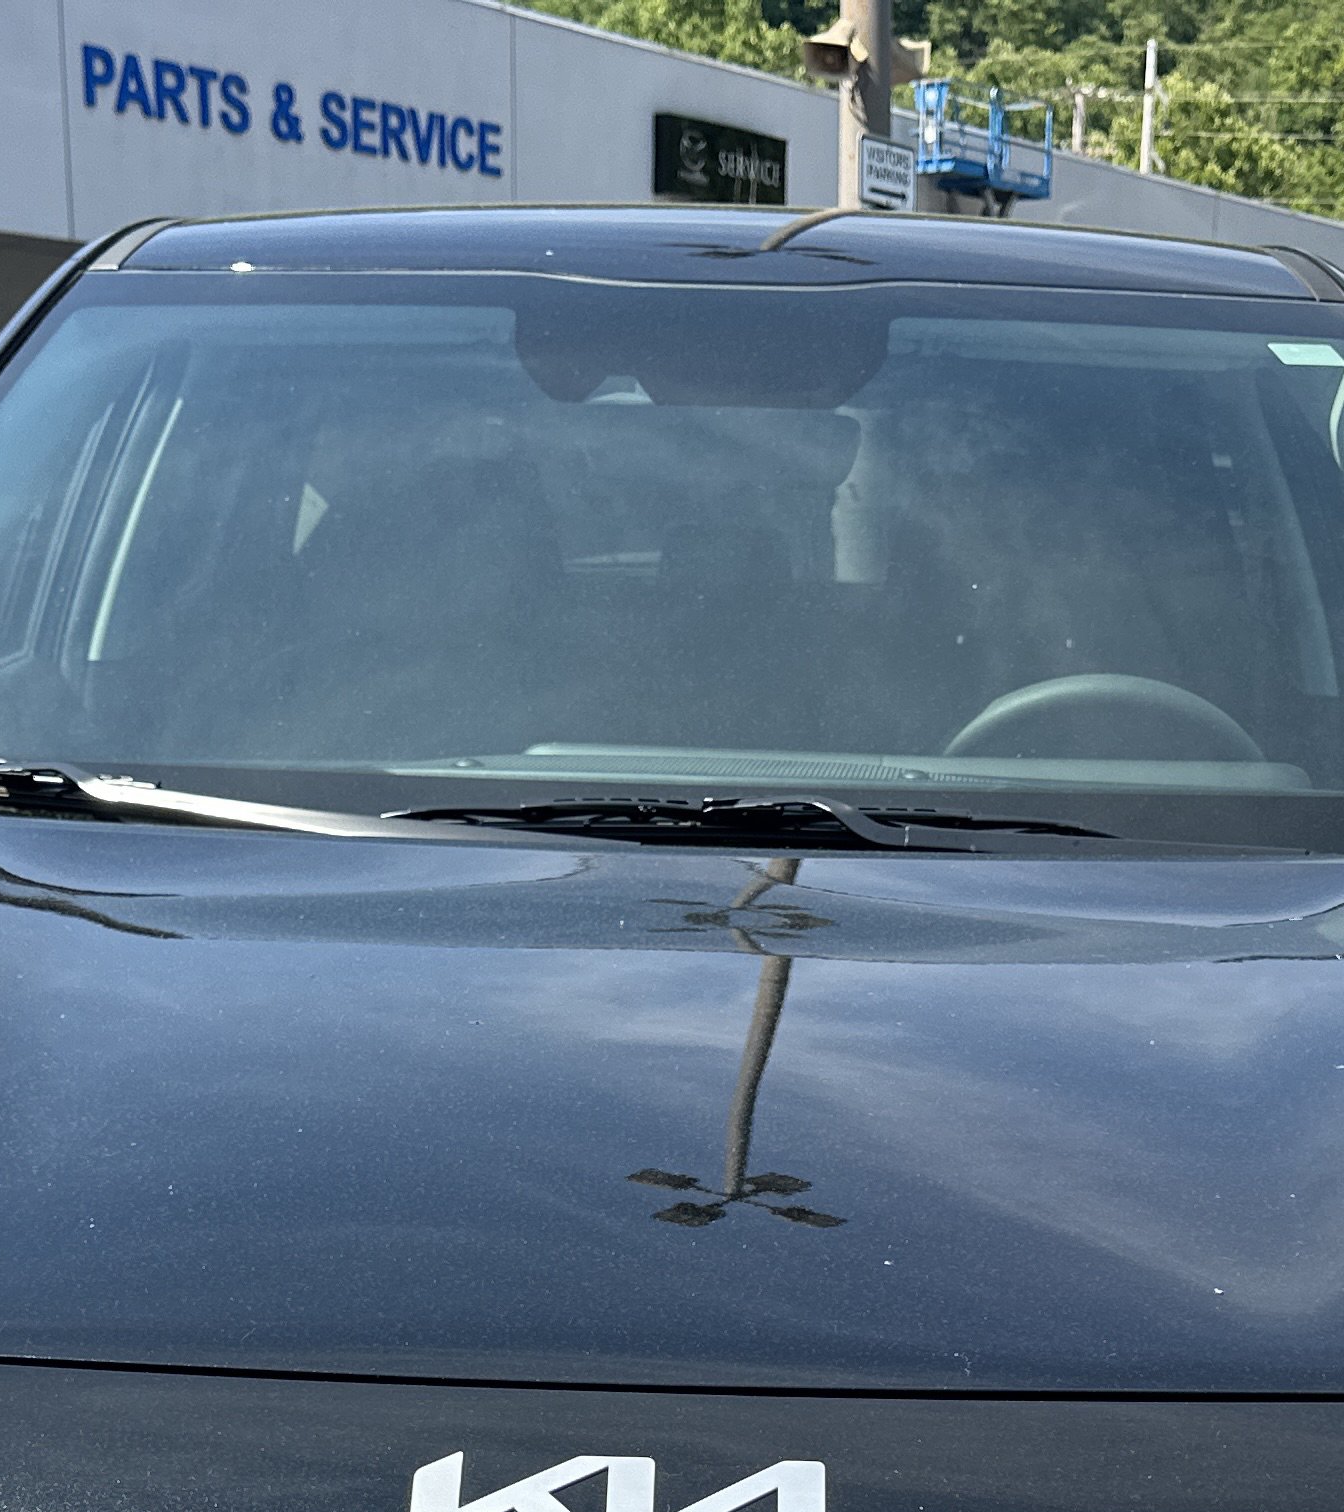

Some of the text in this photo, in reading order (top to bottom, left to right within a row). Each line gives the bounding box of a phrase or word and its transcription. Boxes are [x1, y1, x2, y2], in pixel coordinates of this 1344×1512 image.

[82, 43, 503, 178] PARTS & SERVICE
[717, 148, 782, 188] SERVICE
